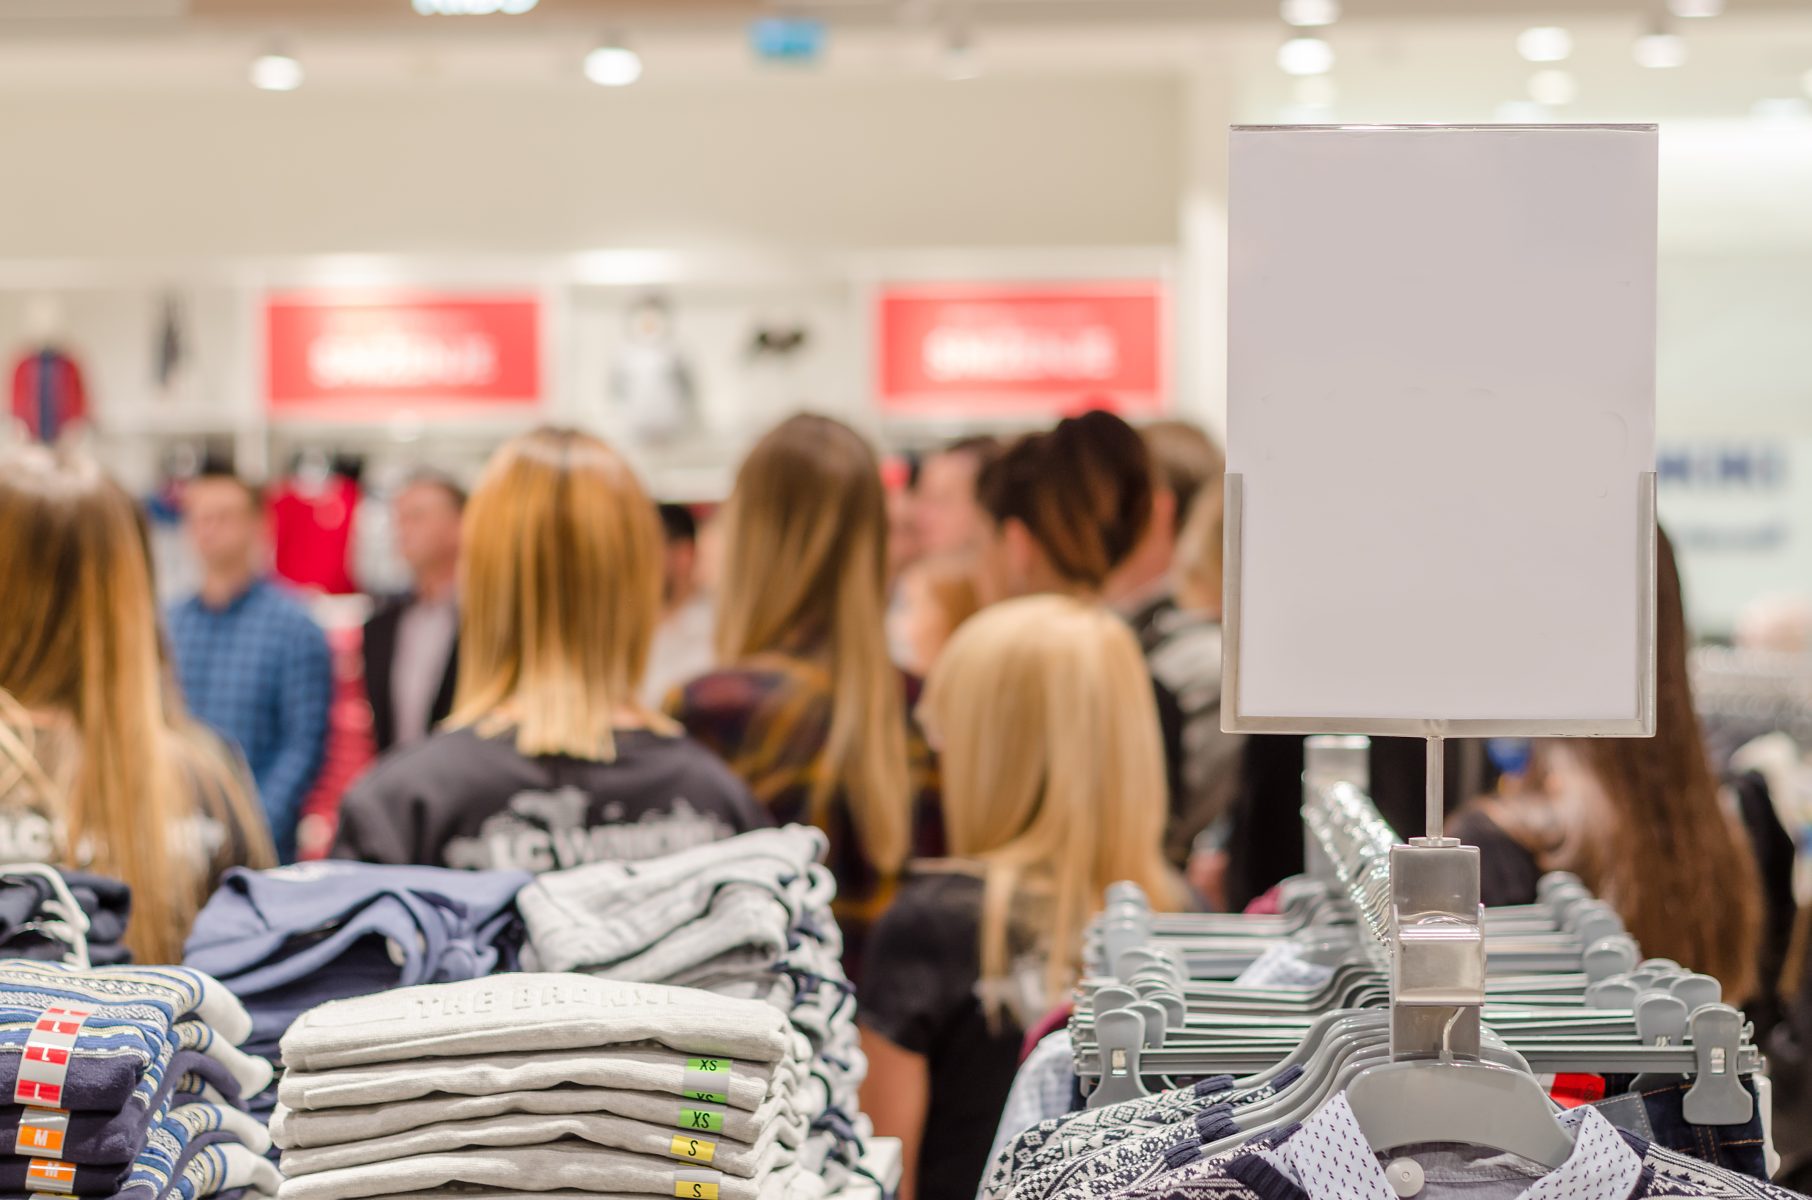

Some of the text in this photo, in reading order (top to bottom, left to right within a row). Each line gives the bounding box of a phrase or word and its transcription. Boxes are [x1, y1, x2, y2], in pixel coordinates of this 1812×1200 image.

[51, 1021, 60, 1033] L
[41, 1047, 50, 1062] L
[699, 1059, 718, 1071] XS
[33, 1083, 42, 1100] L
[692, 1111, 711, 1129] XS
[33, 1129, 49, 1147] M
[688, 1139, 699, 1156] S
[692, 1183, 702, 1198] S
